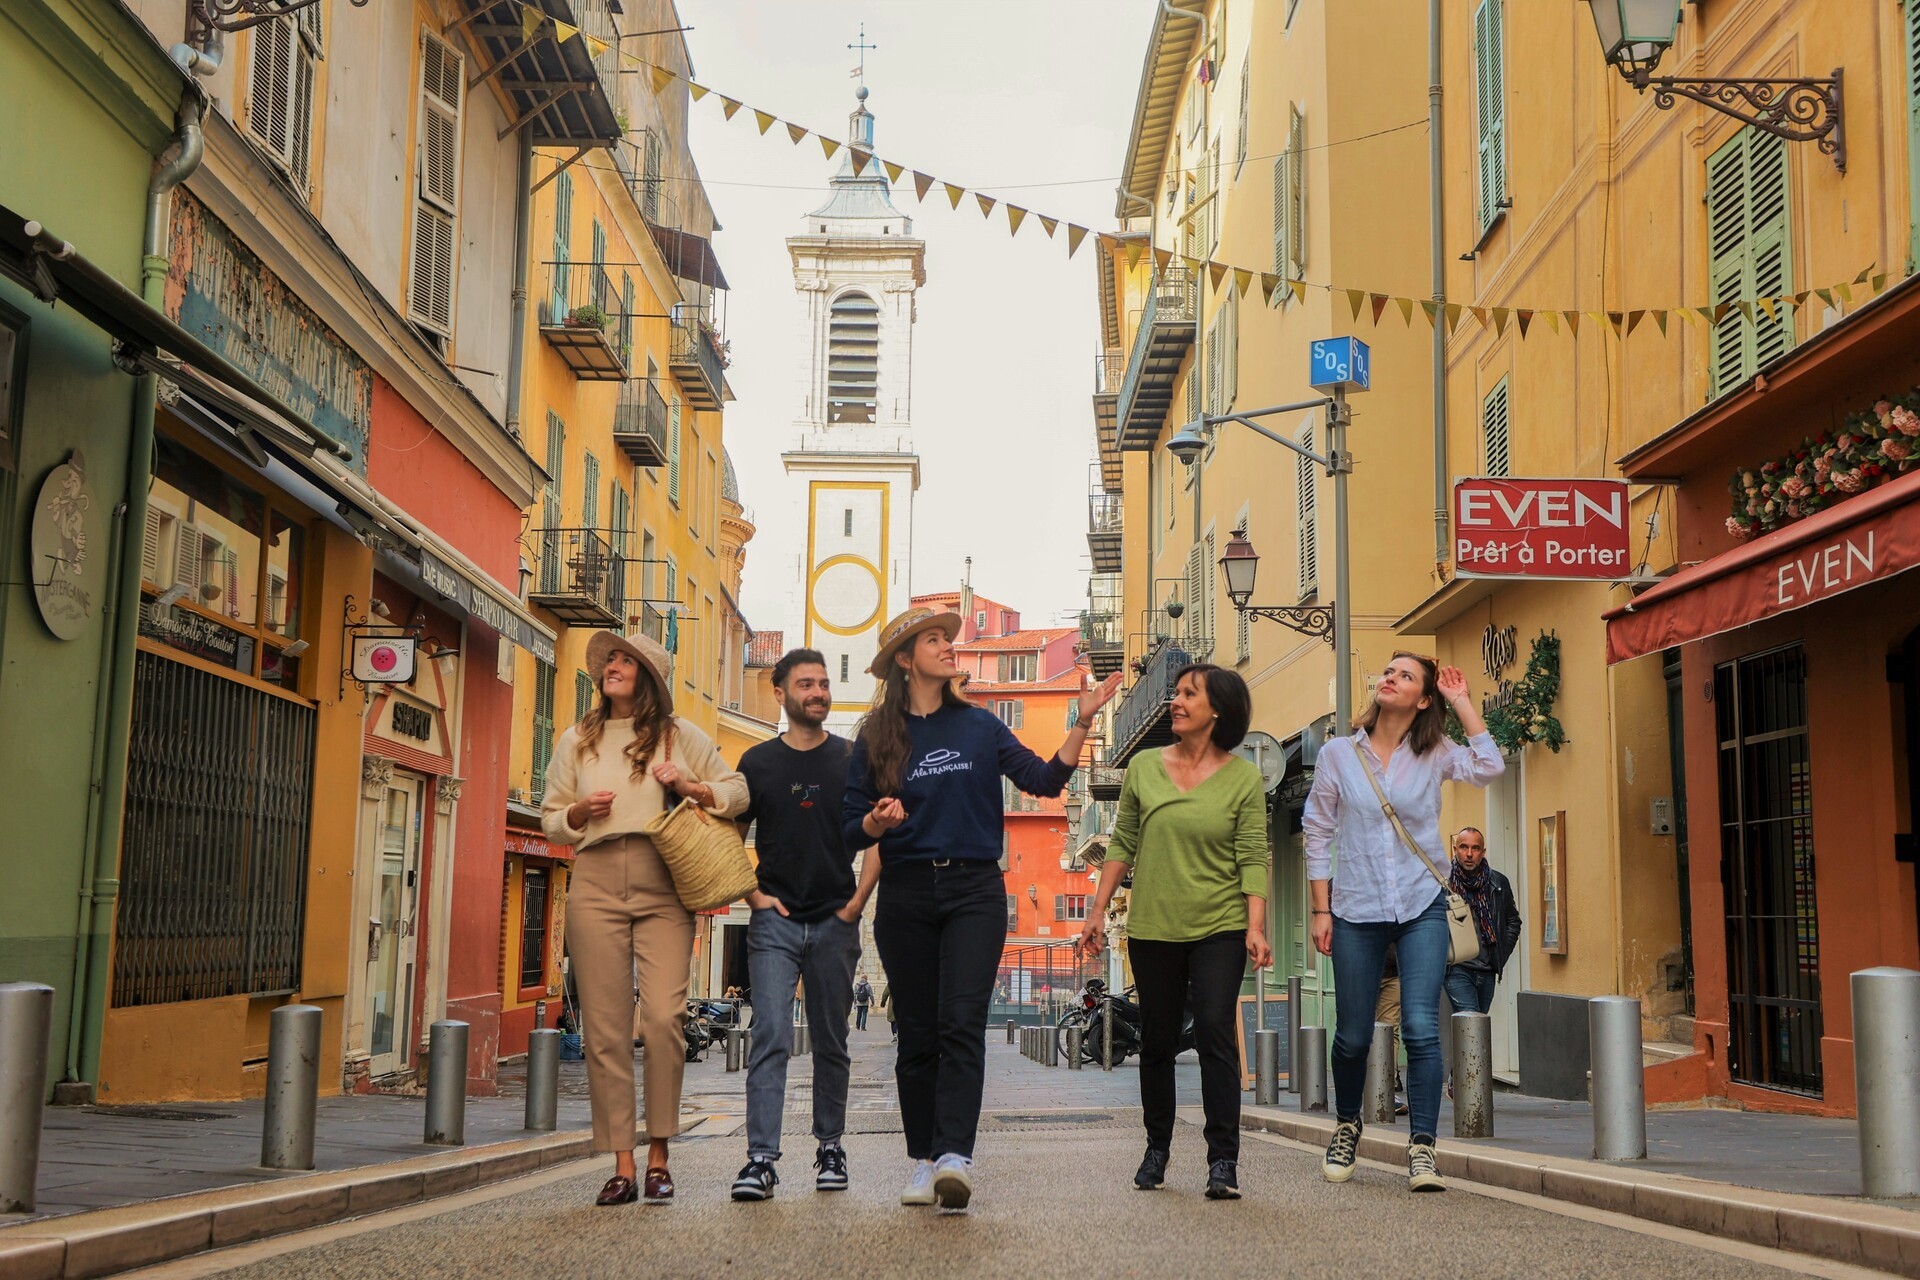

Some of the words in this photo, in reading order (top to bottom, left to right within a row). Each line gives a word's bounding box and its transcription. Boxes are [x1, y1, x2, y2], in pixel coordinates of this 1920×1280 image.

[1314, 341, 1348, 381] SOS
[1353, 340, 1368, 388] SOS
[1460, 488, 1622, 530] EVEN
[1457, 538, 1508, 564] Prêt
[1518, 540, 1535, 564] à
[1546, 540, 1626, 565] Porter
[1778, 530, 1874, 605] EVEN
[422, 560, 436, 586] LIVE
[437, 570, 457, 598] MUSIC
[151, 602, 202, 642] Damoiselle
[203, 622, 236, 655] Bouton
[471, 588, 504, 630] SHAPKO
[504, 611, 519, 641] BAR
[531, 637, 543, 657] JAZZ
[543, 644, 555, 664] CLUB
[392, 701, 432, 741] SHAPKO
[519, 837, 551, 856] Juliette
